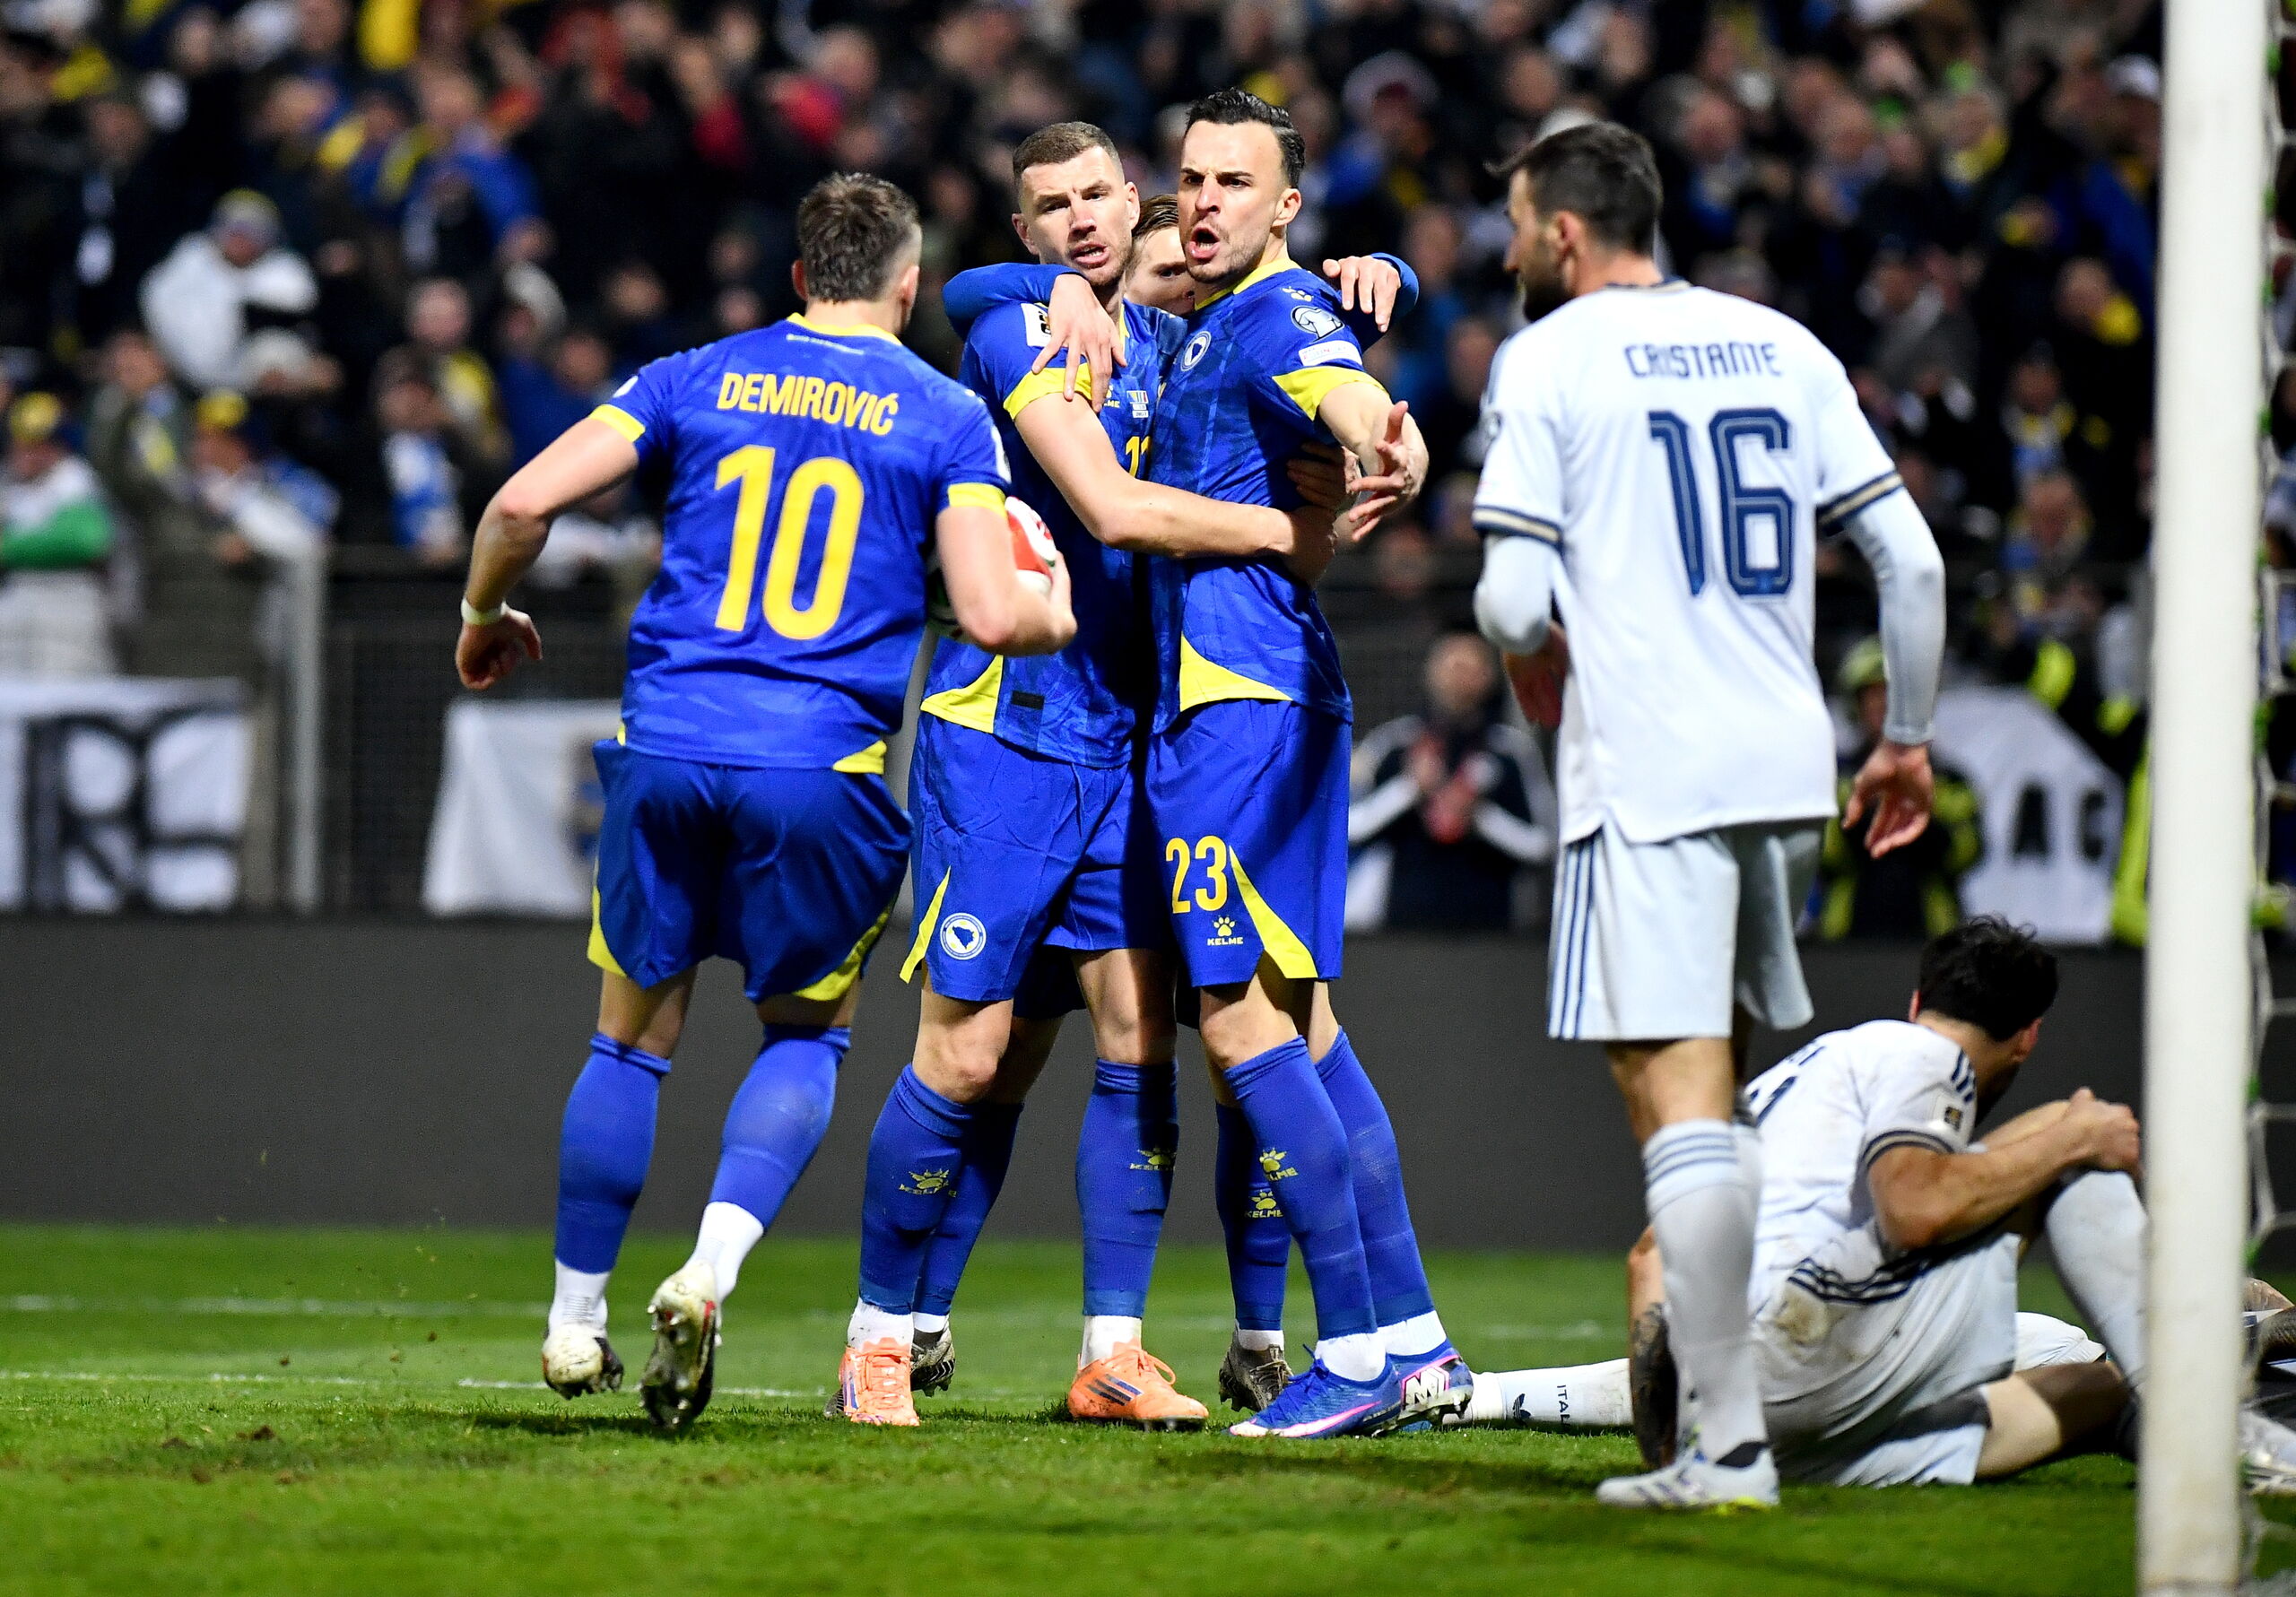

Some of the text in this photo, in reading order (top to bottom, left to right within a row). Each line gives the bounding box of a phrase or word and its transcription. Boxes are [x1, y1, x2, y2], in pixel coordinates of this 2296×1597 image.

[716, 371, 900, 436] DEMIROVIĆ
[714, 444, 865, 640] 10
[1647, 407, 1795, 597] 16
[1165, 835, 1228, 915] 23
[1206, 936, 1244, 946] KELME
